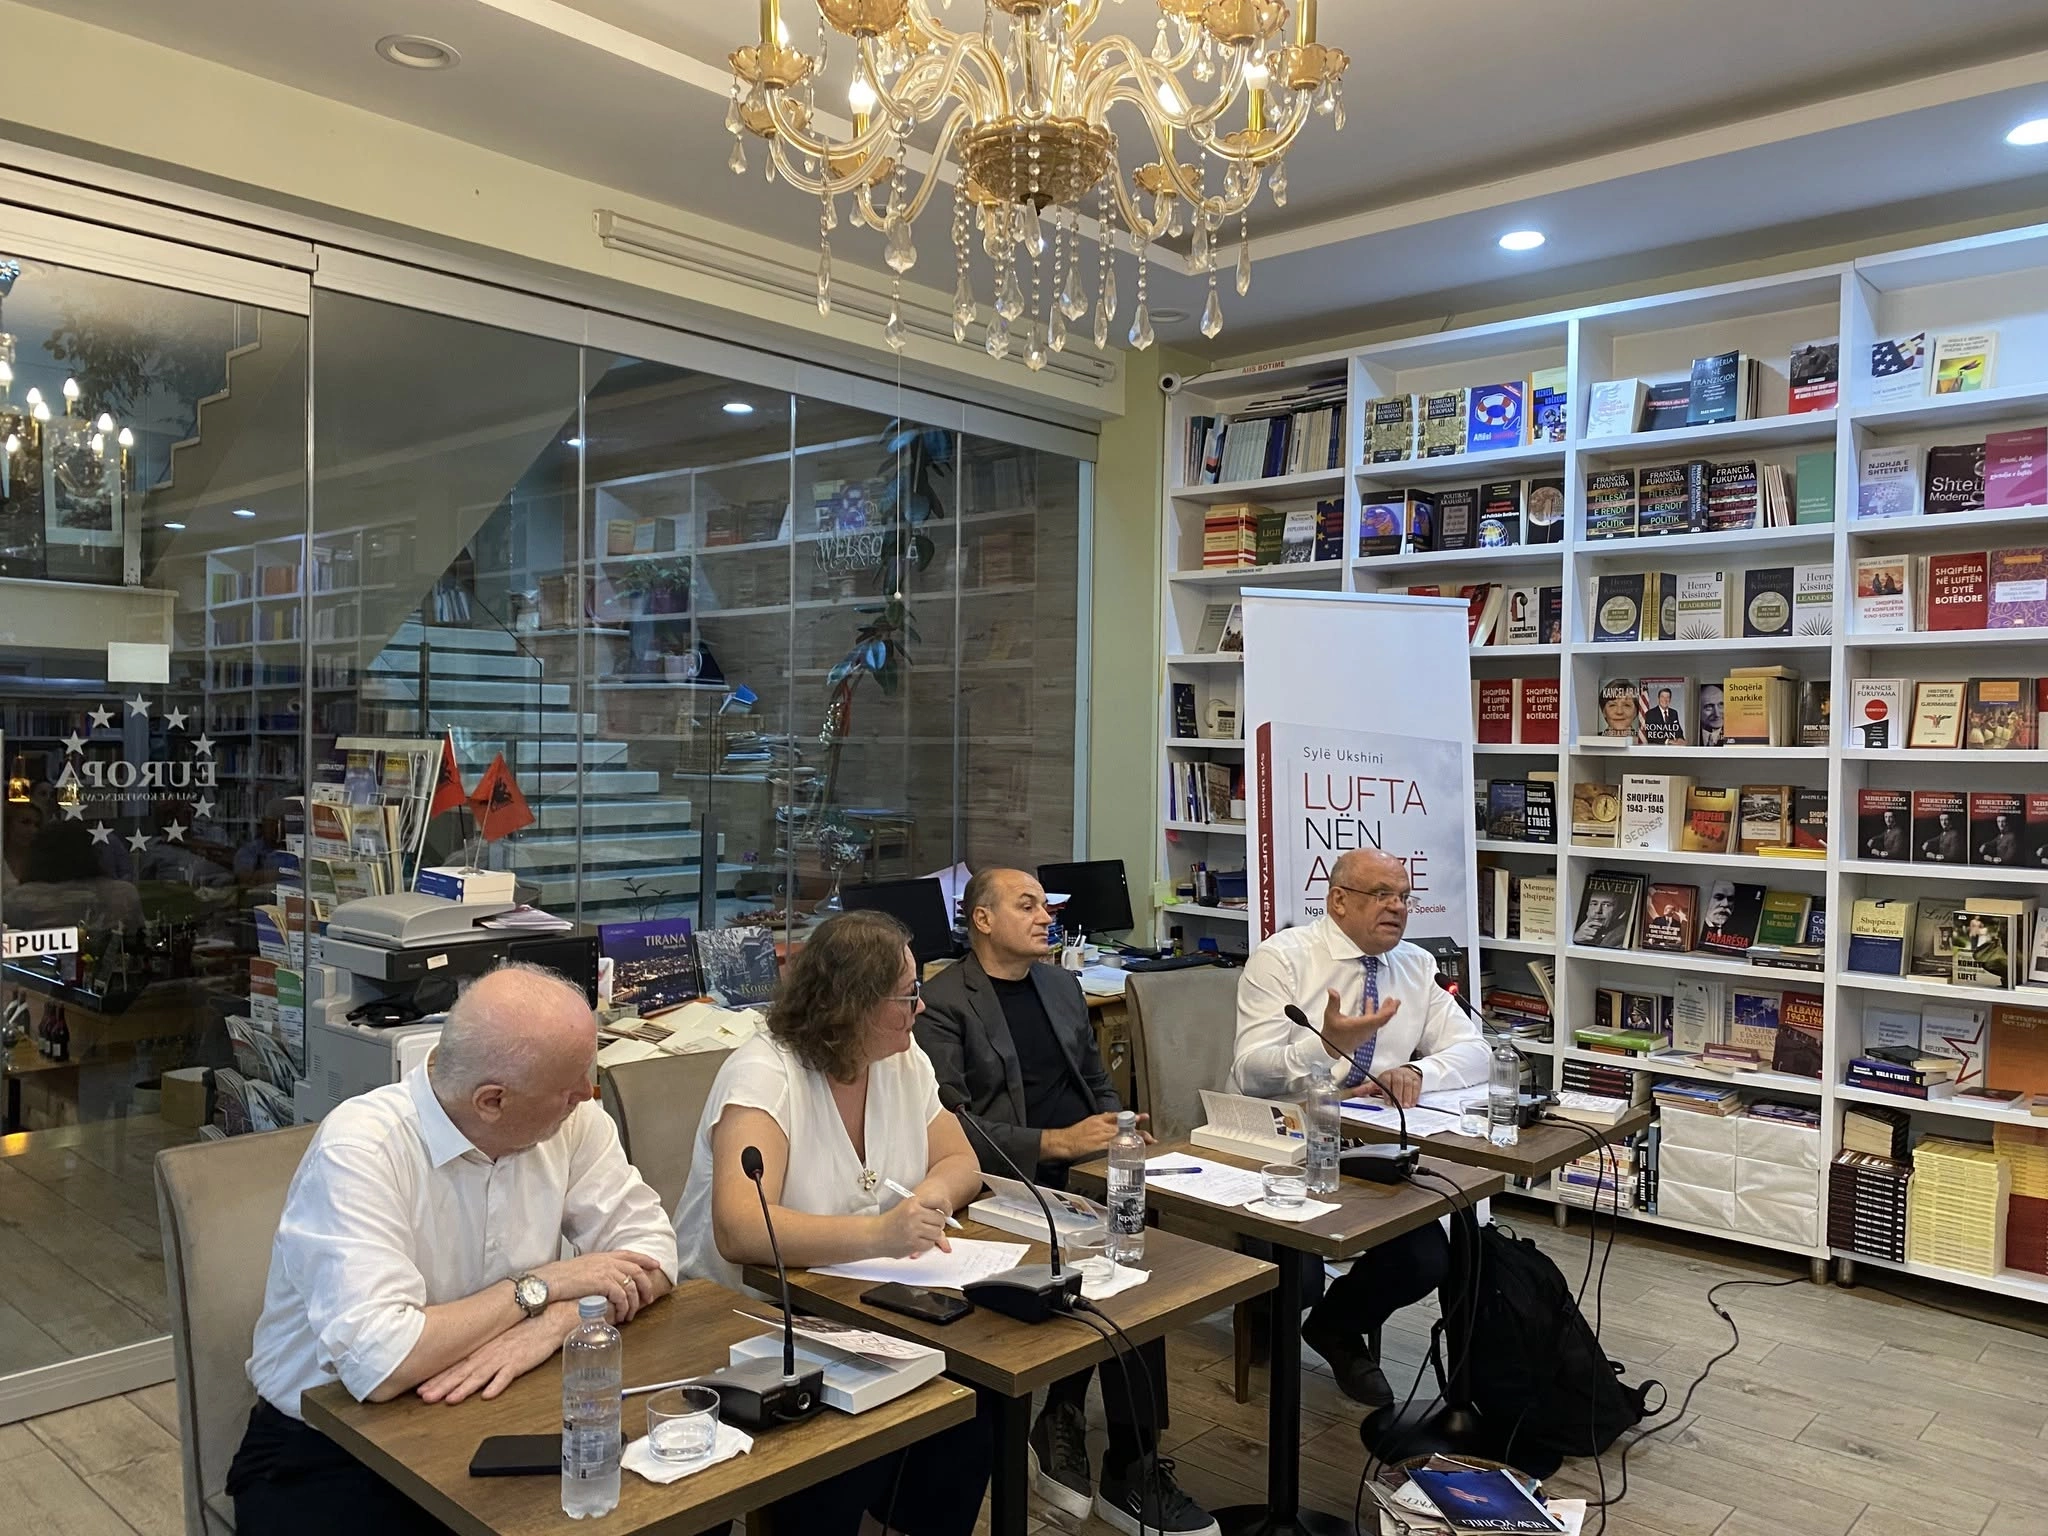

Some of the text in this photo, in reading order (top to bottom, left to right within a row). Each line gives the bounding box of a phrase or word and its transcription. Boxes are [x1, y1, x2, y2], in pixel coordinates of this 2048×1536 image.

[1258, 361, 1285, 371] BOTIME
[1693, 373, 1736, 386] TRANZICION
[1429, 407, 1454, 415] EUROPIAN
[1868, 460, 1901, 469] NJOHJA
[1649, 469, 1681, 479] FRANCIS
[1716, 465, 1749, 476] FRANCIS
[1868, 466, 1909, 476] SHTETEVE
[1596, 474, 1625, 484] FRANCIS
[1646, 475, 1685, 485] FUKUYAMA
[1711, 472, 1756, 484] FUKUYAMA
[1593, 479, 1630, 490] FUKUYAMA
[1931, 476, 1984, 492] Shteti
[1595, 492, 1627, 503] FILLESAT
[1648, 488, 1682, 498] FILLESAT
[1930, 491, 1969, 501] Modern
[1601, 506, 1628, 515] RENDIT
[1654, 502, 1683, 511] RENDIT
[1596, 519, 1624, 528] POLITIK
[1650, 515, 1679, 524] POLITIK
[1935, 565, 1983, 576] SHQIPËRIA
[1936, 574, 1982, 585] NË LUFTËN
[1687, 581, 1713, 591] Henry
[1944, 584, 1974, 594] E DYTË
[1681, 590, 1719, 600] Kissinger
[1935, 594, 1983, 605] BOTËRORE
[1679, 601, 1721, 610] LEADERSHIP
[1483, 688, 1510, 696] SHQIPËRIA
[1729, 683, 1763, 693] Shoqëria
[1527, 695, 1557, 703] NË LUFTËN
[1730, 693, 1763, 702] anarkike
[1645, 723, 1679, 732] RONALD
[1647, 731, 1676, 739] REGAN
[1303, 746, 1384, 764] Sylë Ukshini
[1304, 772, 1427, 815] LUFTA
[1626, 792, 1664, 804] SHQIPËRIA
[1527, 807, 1549, 816] VALA
[1528, 817, 1550, 827] E TRETË
[1306, 813, 1381, 850] NËN
[1625, 817, 1664, 844] SECRET
[1588, 880, 1634, 895] HAVELI
[1305, 906, 1324, 916] Nga
[1415, 905, 1446, 914] Speciale
[1856, 925, 1870, 933] dhe
[15, 933, 71, 952] PULL
[644, 933, 686, 947] TIRANA
[1705, 931, 1749, 948] PAVARËSIA
[1517, 1520, 1549, 1529] NEW
